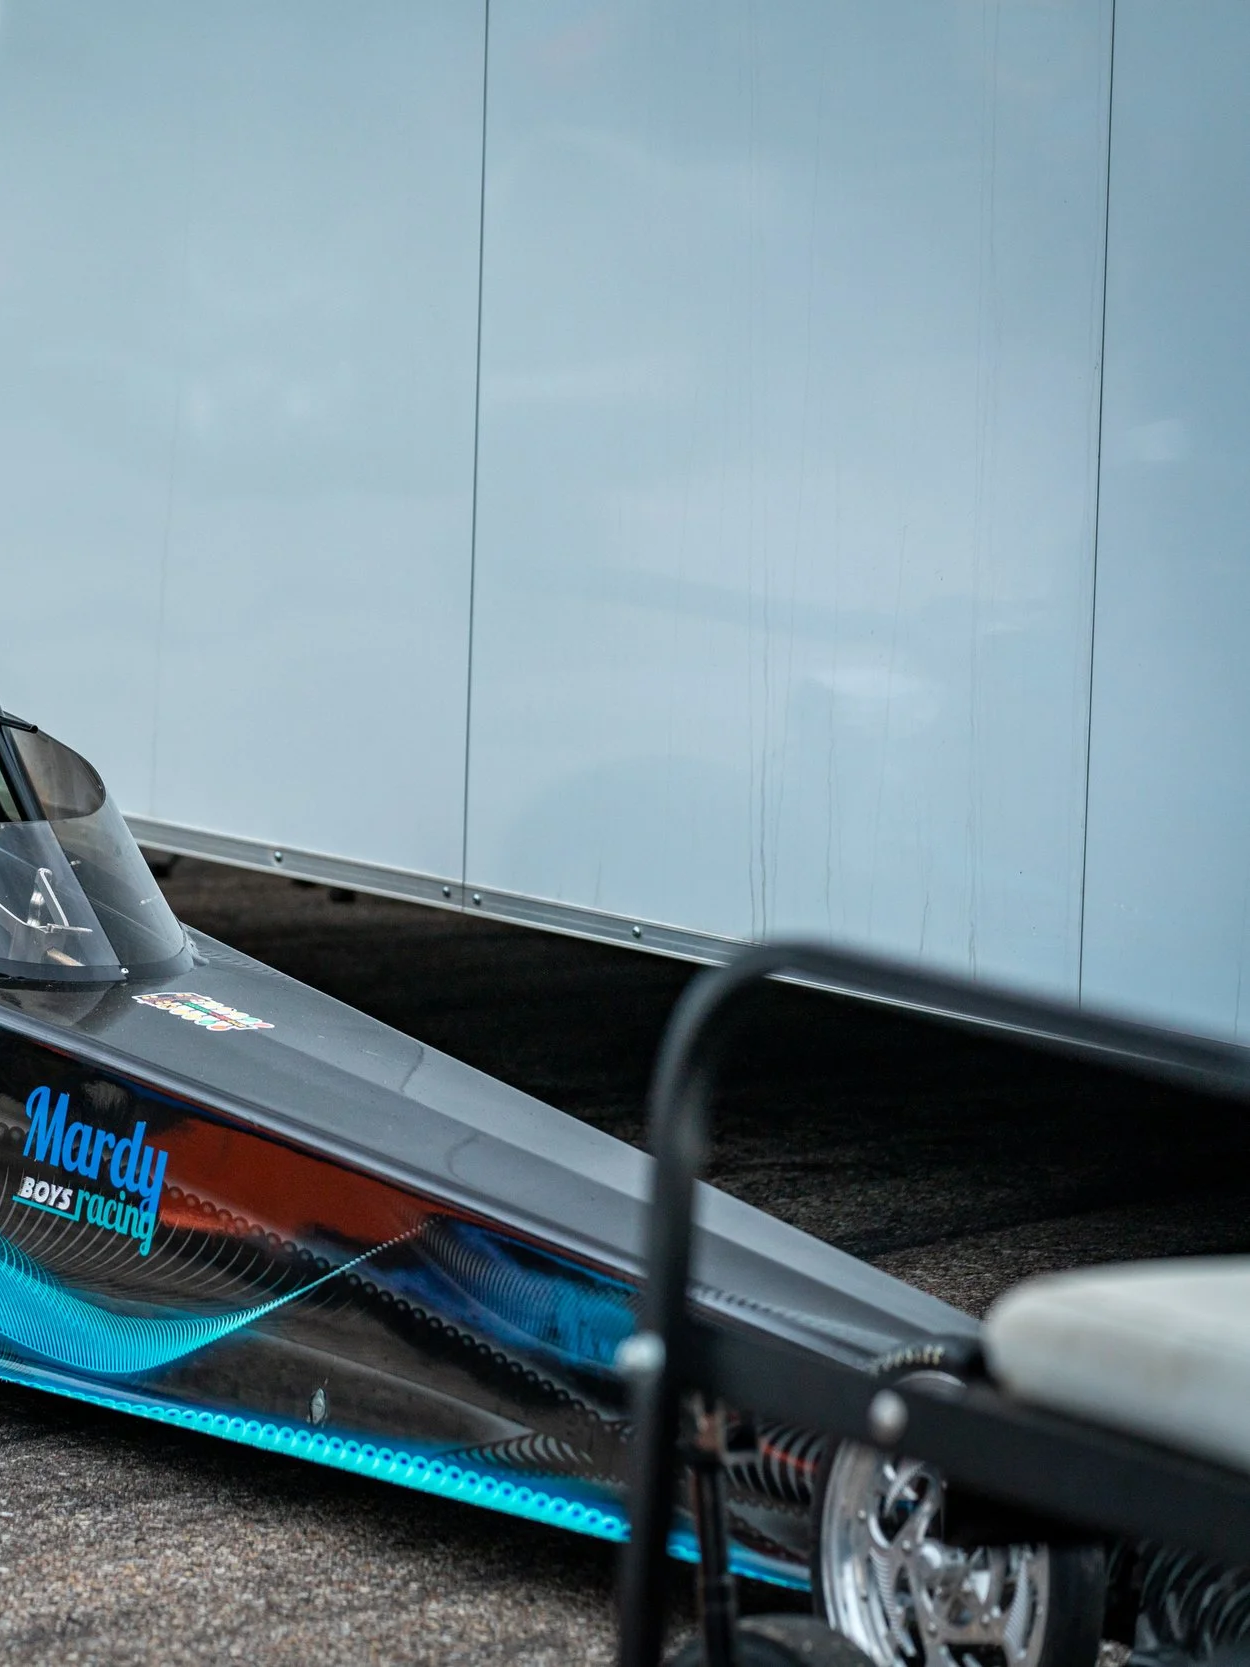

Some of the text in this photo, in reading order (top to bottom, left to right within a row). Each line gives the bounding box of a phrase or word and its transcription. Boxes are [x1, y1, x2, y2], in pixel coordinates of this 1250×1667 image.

[23, 1085, 168, 1214] Mardy
[18, 1176, 156, 1257] BOYS racing
